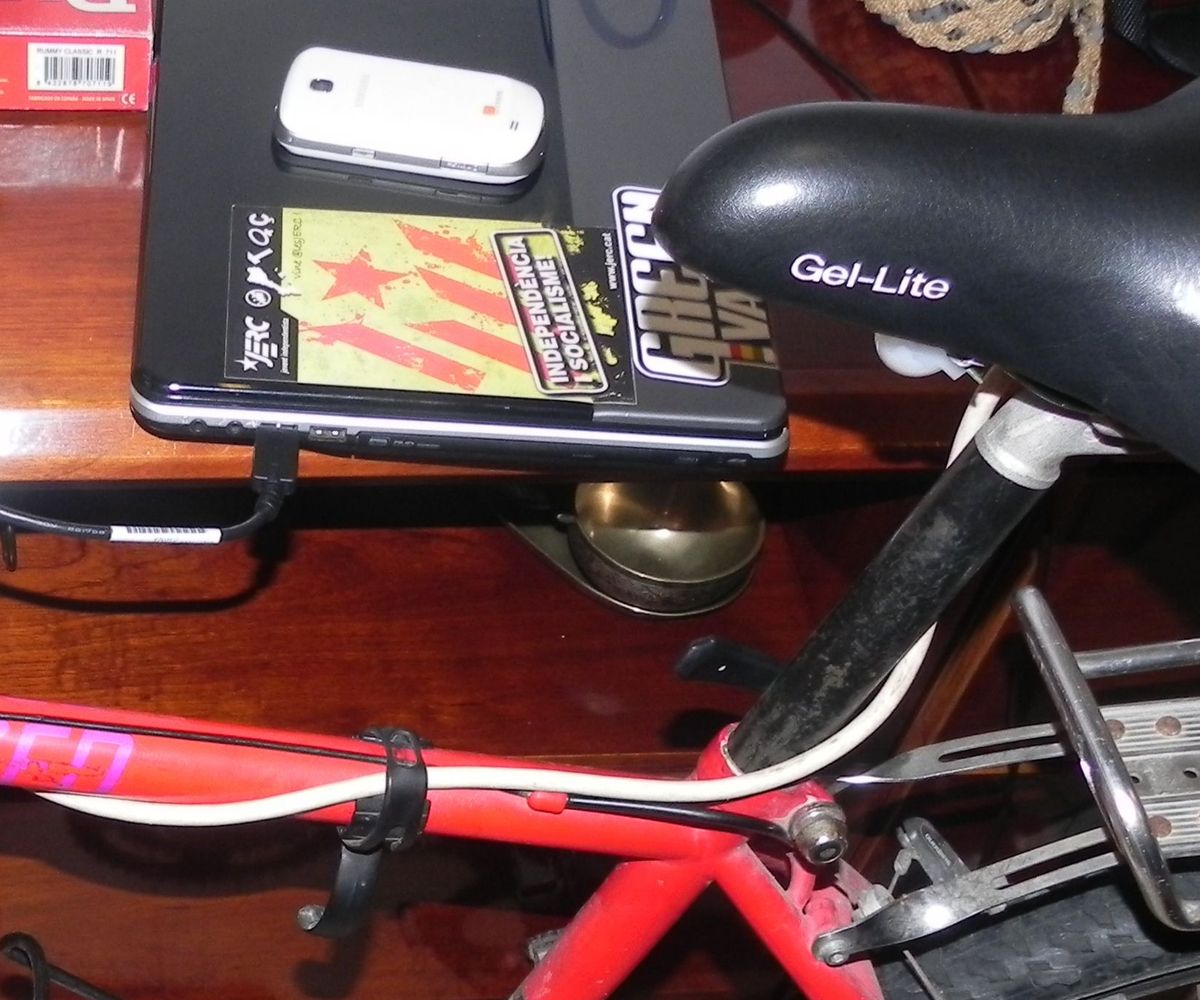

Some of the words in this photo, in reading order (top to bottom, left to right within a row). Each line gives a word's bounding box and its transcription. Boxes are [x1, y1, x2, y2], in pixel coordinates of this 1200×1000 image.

[601, 232, 618, 291] www.jerc.cat
[790, 252, 951, 300] Gel-Lite
[509, 236, 570, 383] INDEPENDÈNCIA
[244, 315, 278, 368] JERC
